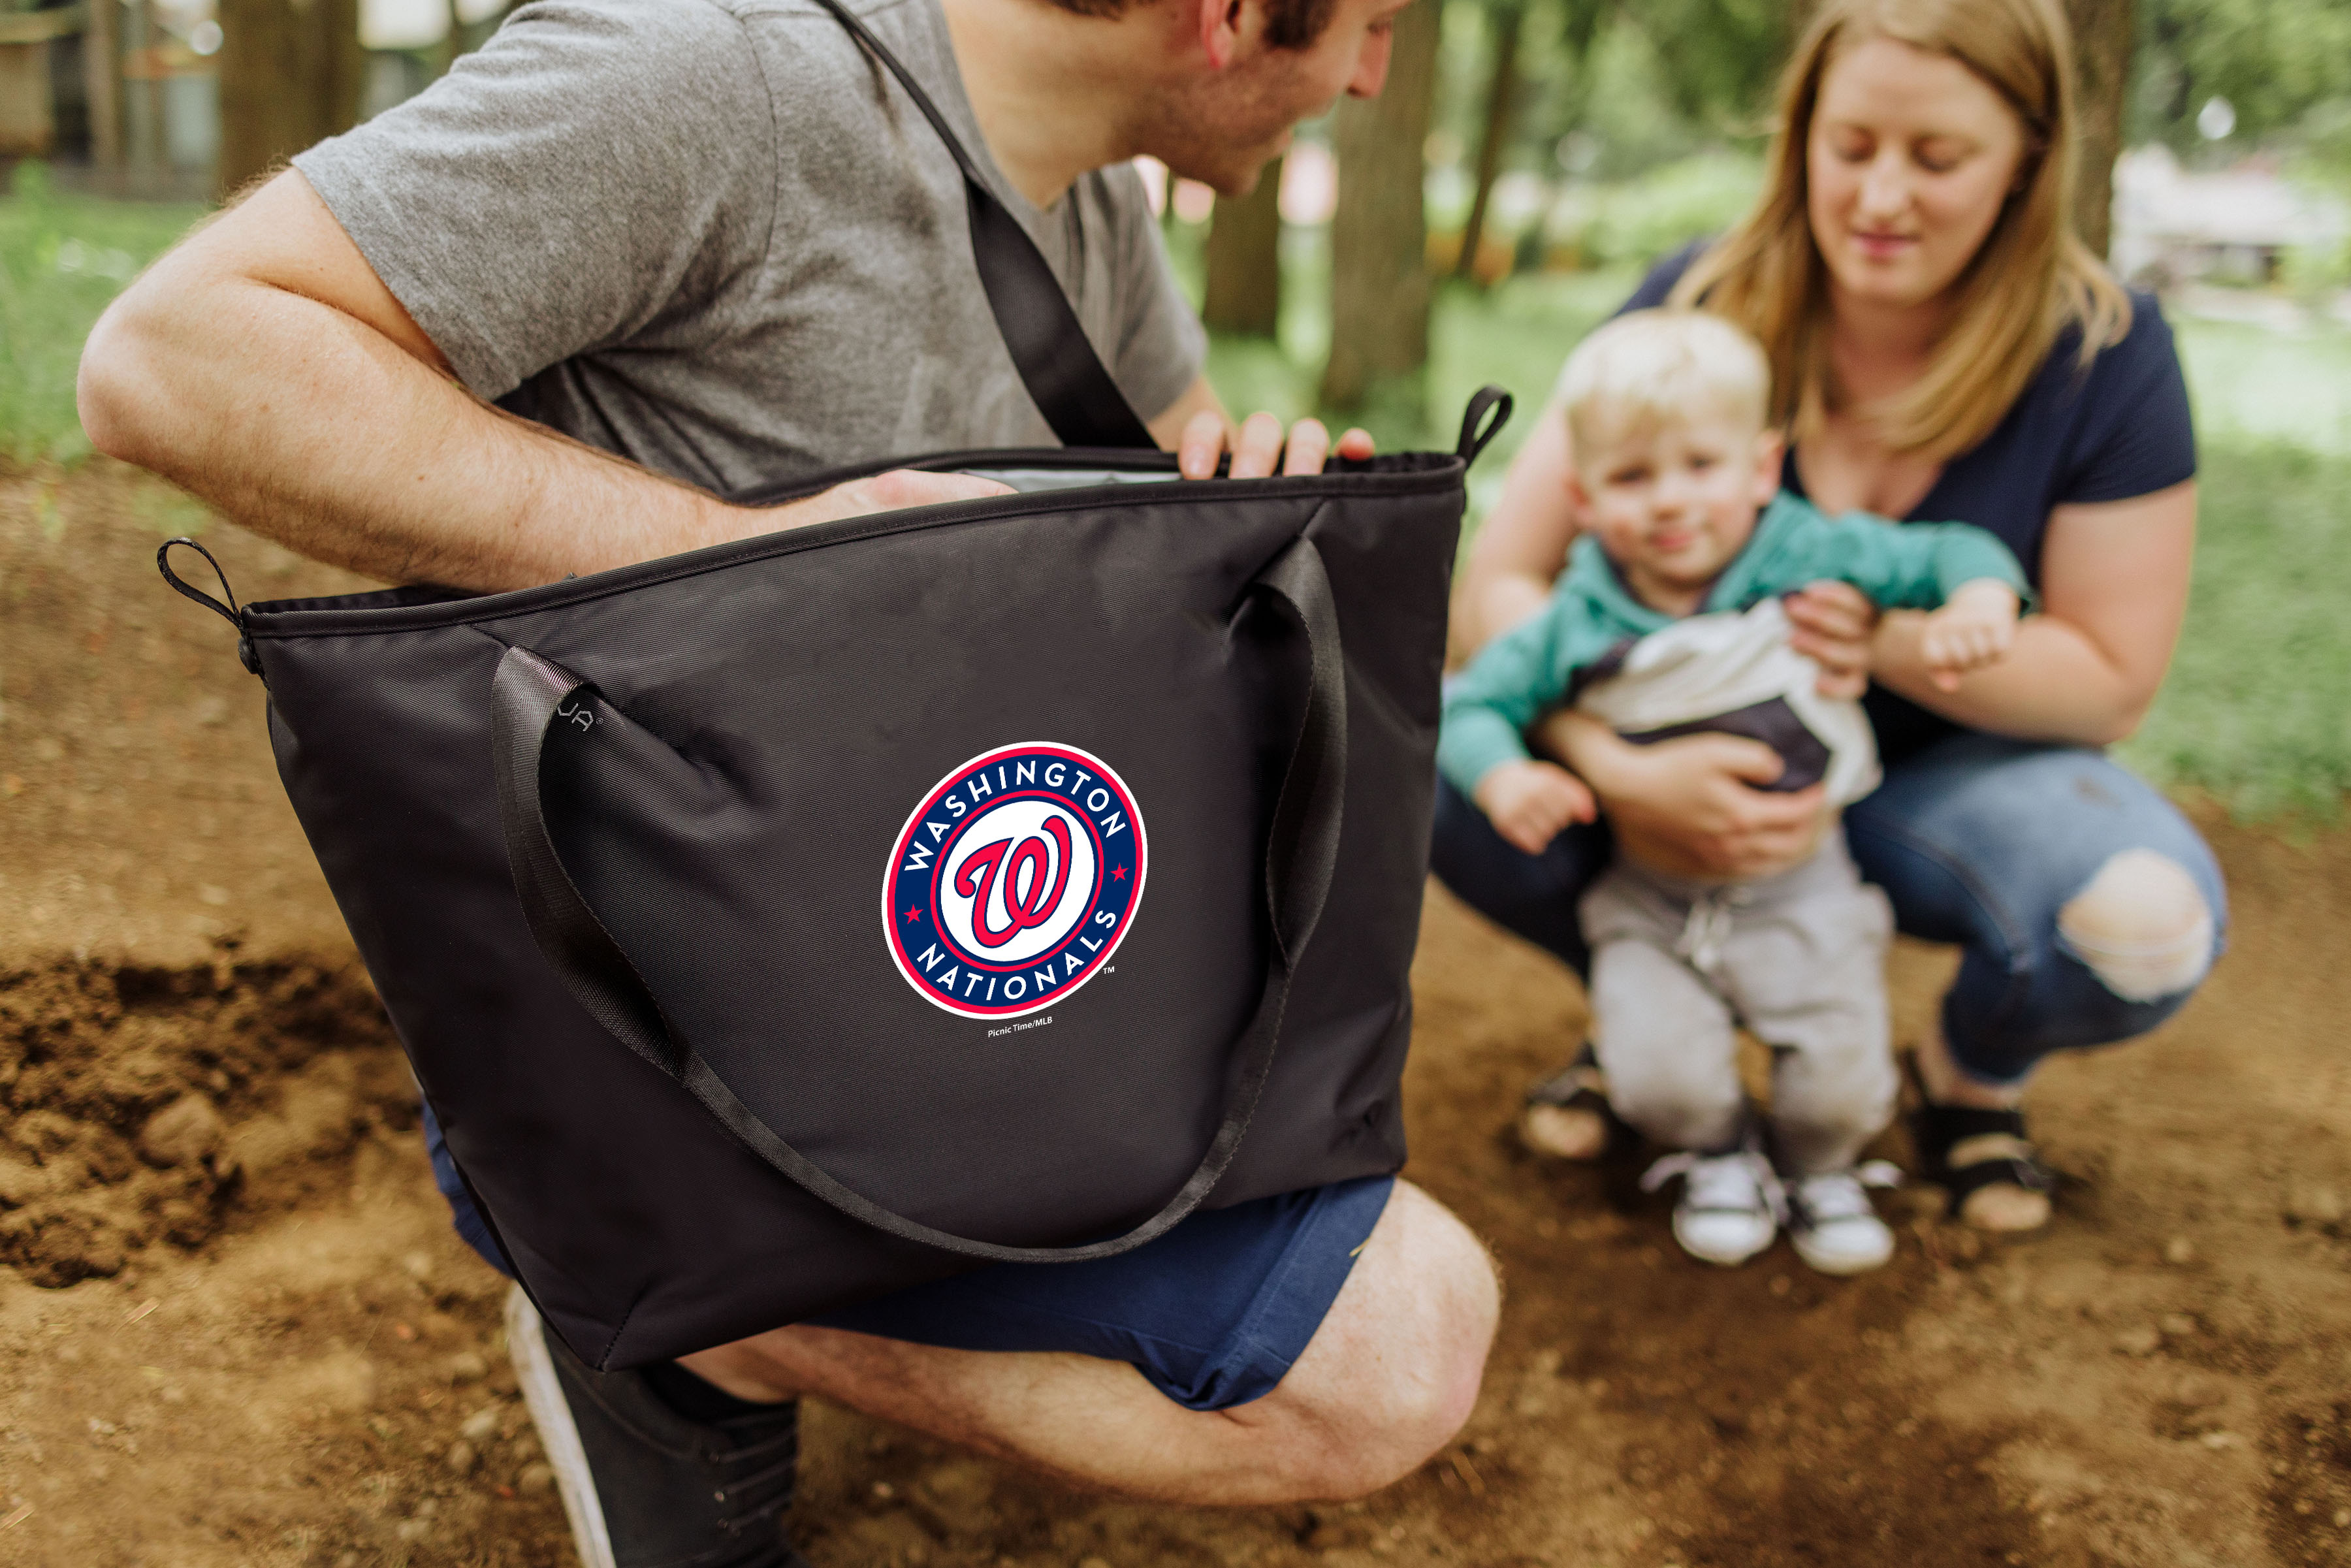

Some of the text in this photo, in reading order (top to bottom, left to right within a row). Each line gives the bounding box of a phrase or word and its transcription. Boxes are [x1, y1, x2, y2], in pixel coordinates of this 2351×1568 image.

[904, 760, 1127, 872] WASHINGTON
[954, 814, 1073, 949] W
[916, 909, 1117, 1001] NATIONALS
[1102, 966, 1115, 975] TM
[987, 1016, 1053, 1038] Picnic Time/MLB
